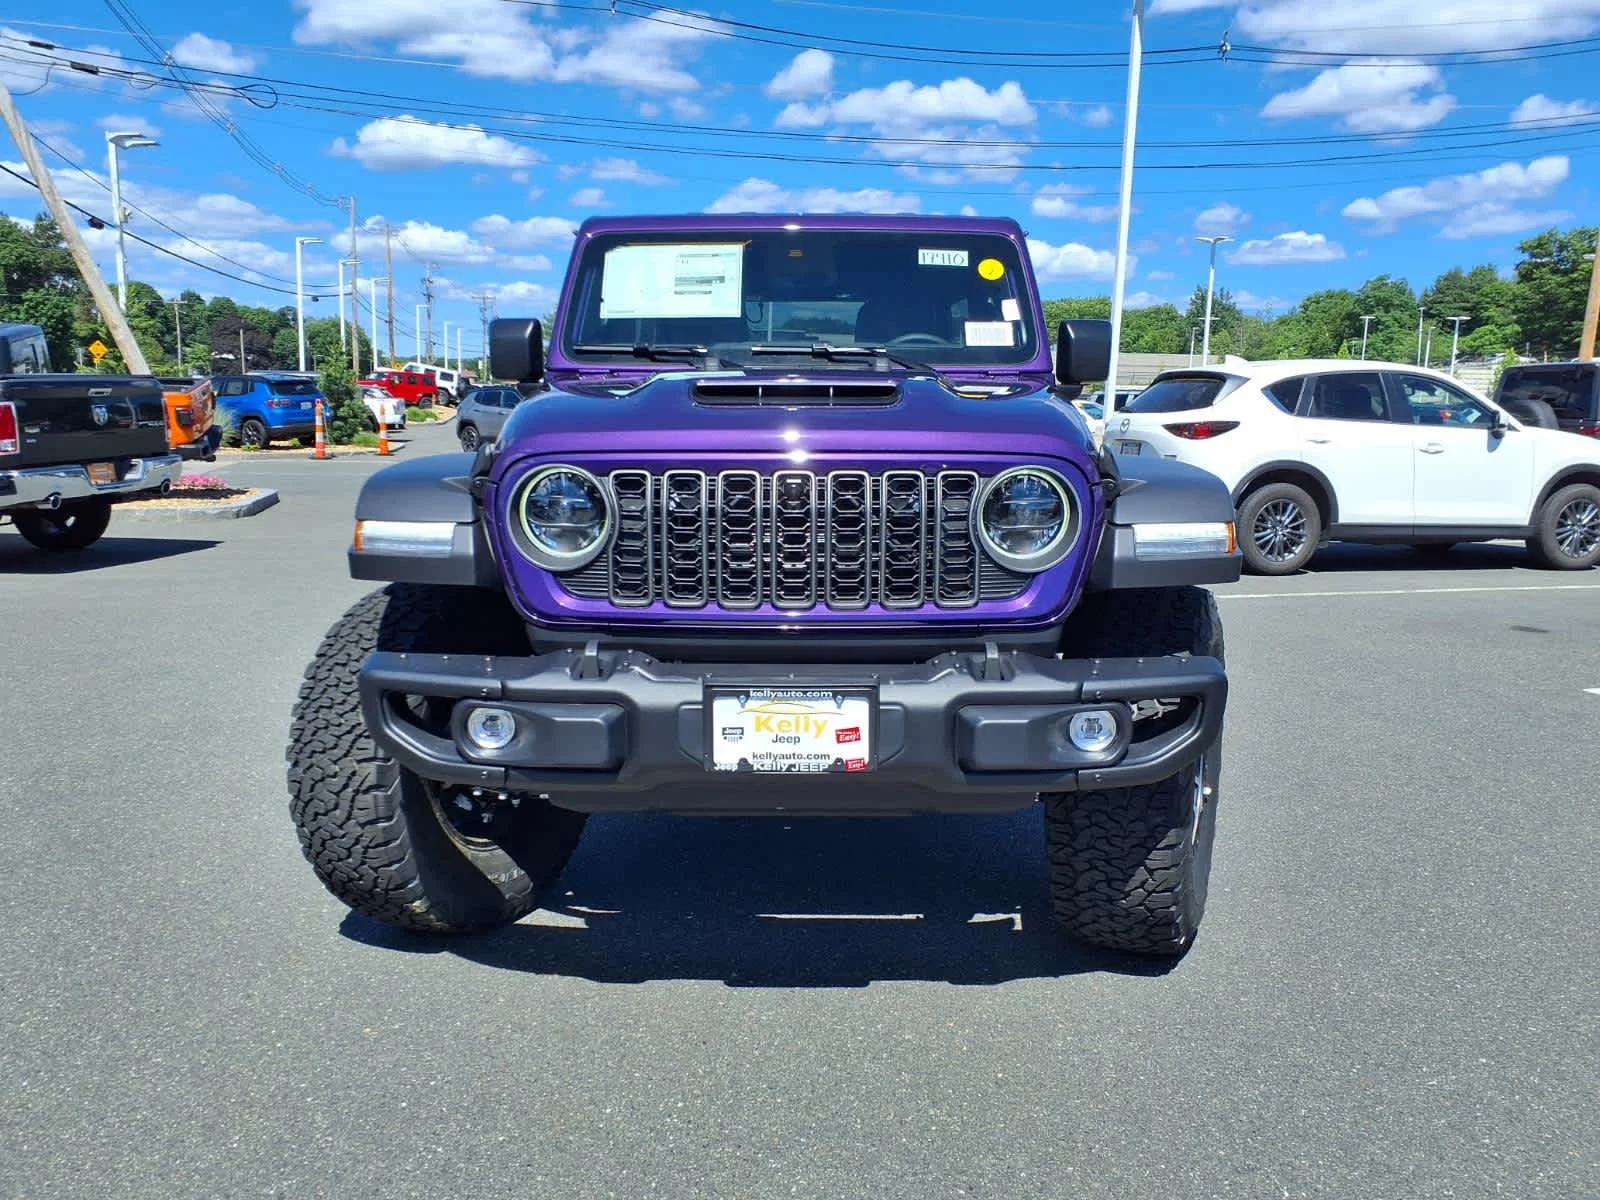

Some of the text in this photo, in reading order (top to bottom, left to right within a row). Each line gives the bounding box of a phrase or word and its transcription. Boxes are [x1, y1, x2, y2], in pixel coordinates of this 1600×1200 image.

[750, 688, 833, 698] kellyauto.com
[754, 715, 828, 739] Kelly
[771, 734, 801, 745] Jeep
[752, 752, 831, 762] kellyauto.com
[791, 762, 829, 772] JEEP
